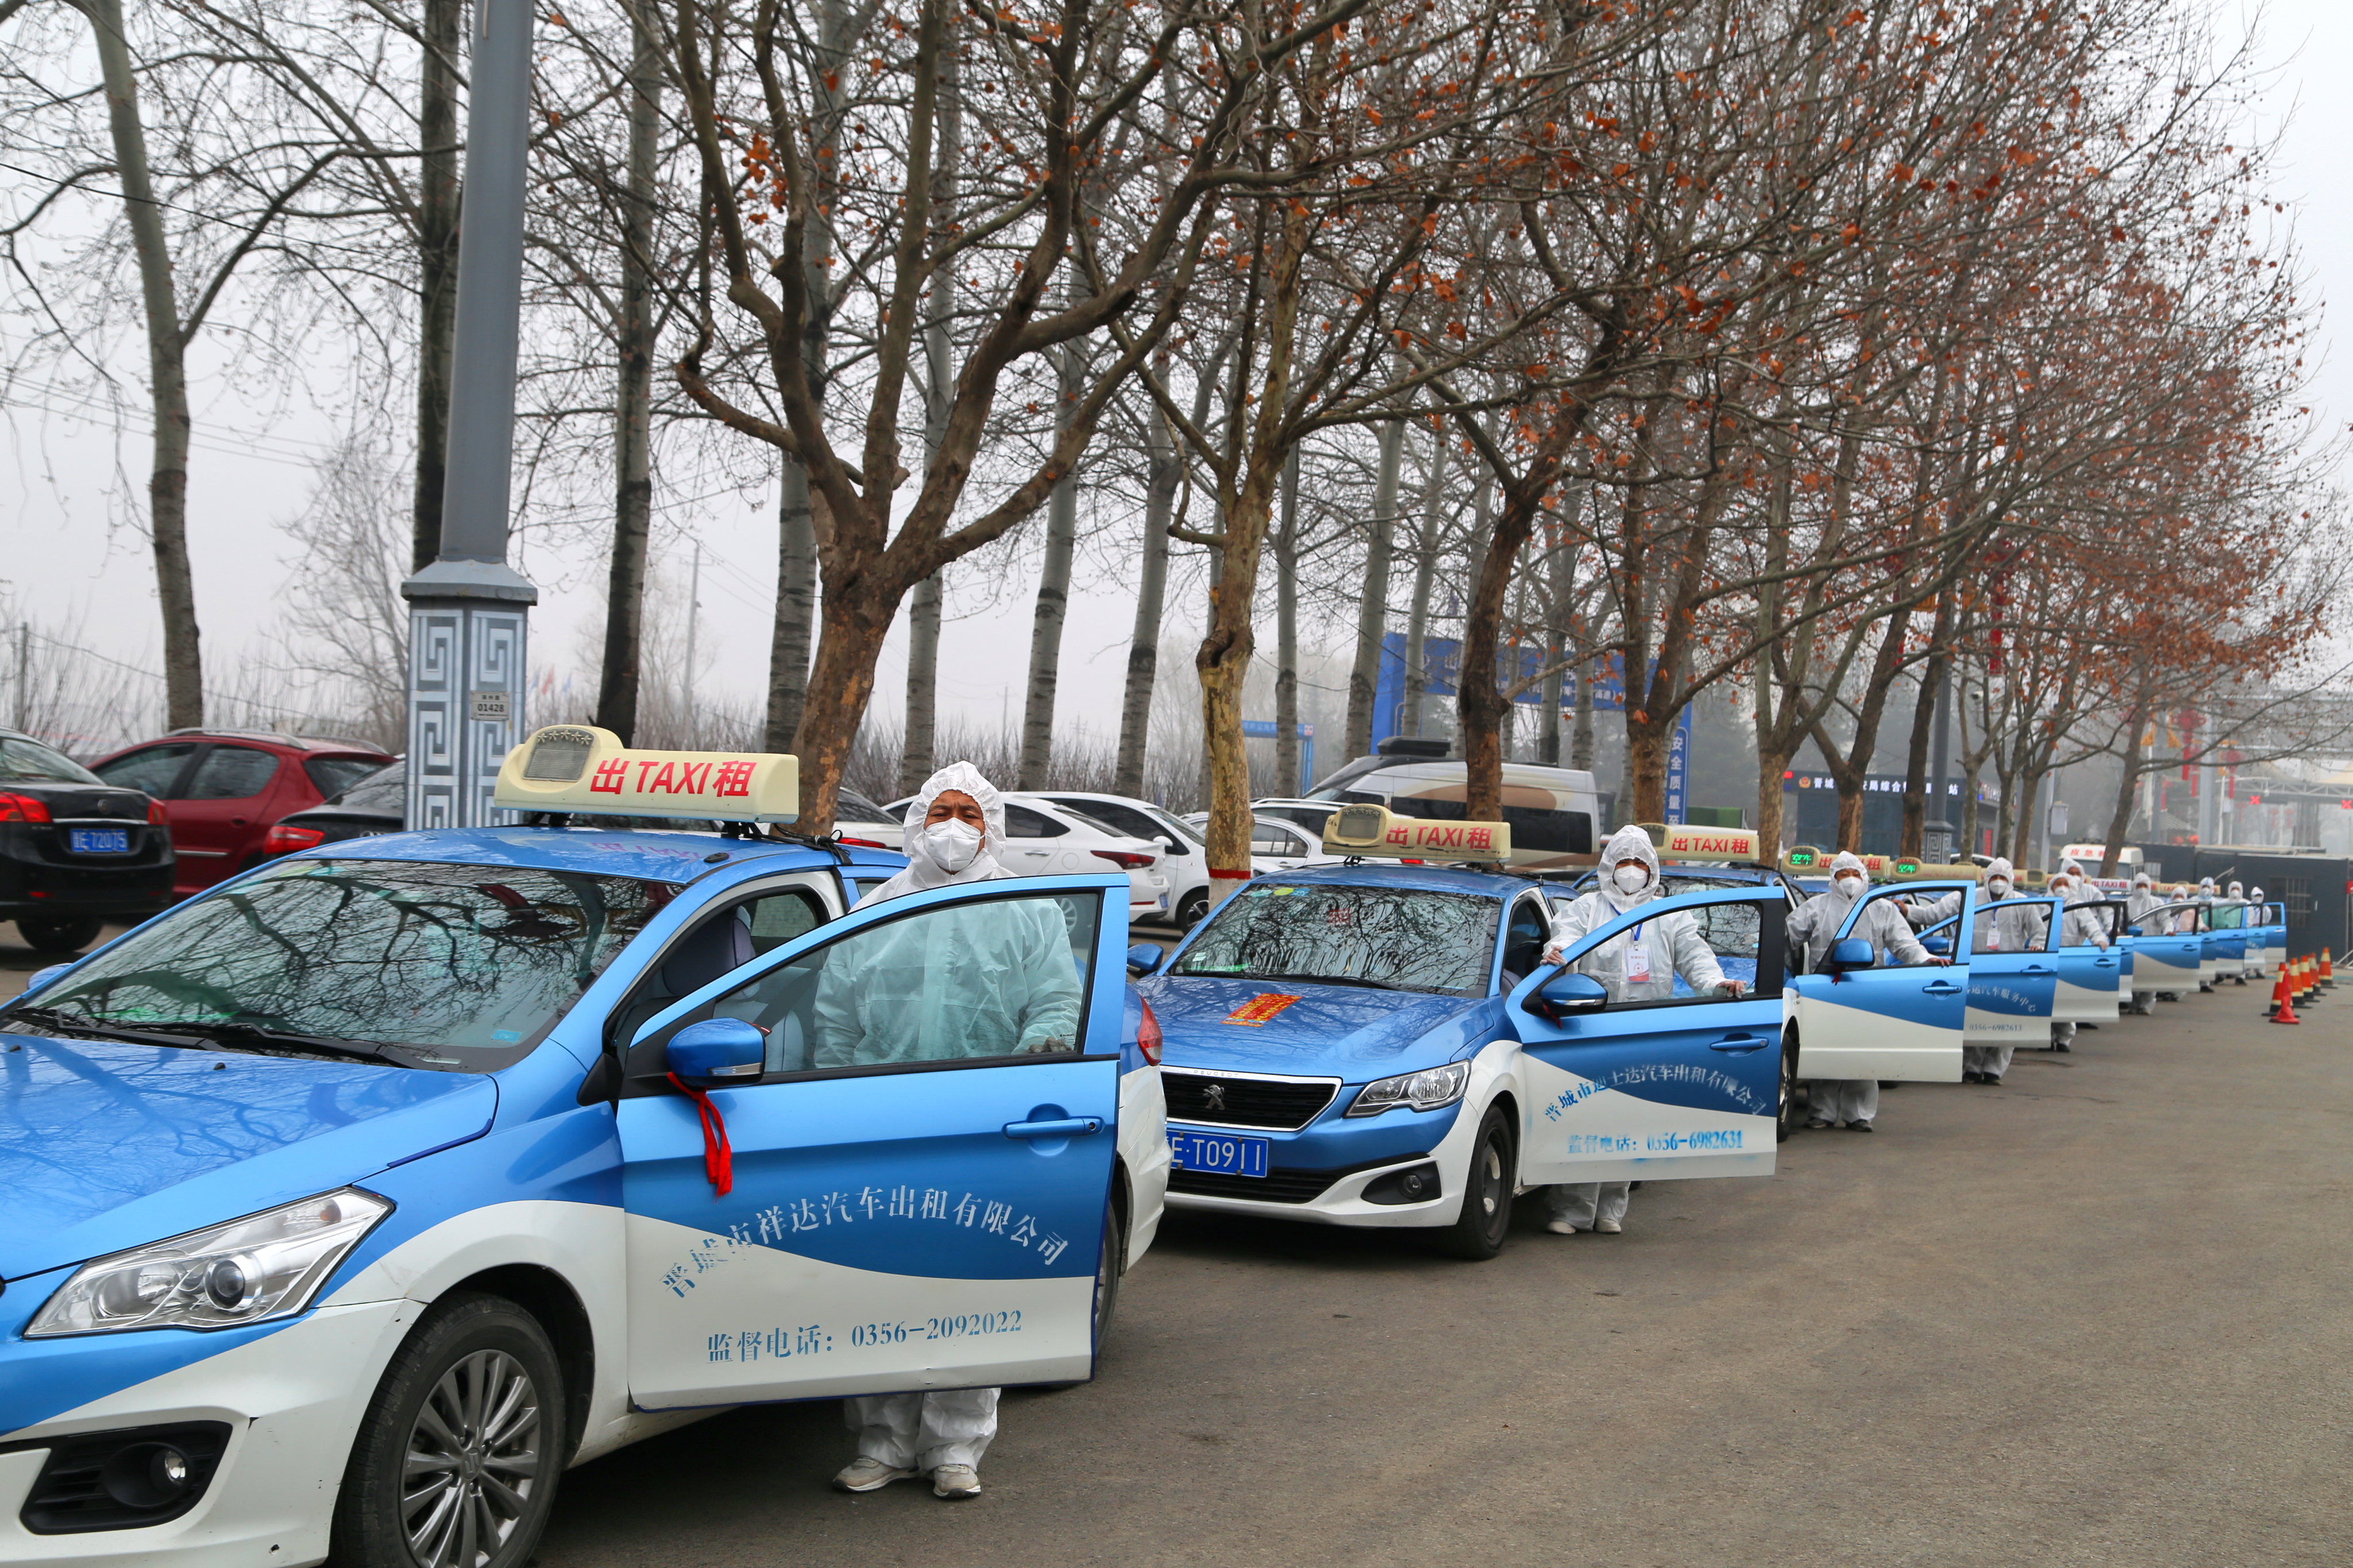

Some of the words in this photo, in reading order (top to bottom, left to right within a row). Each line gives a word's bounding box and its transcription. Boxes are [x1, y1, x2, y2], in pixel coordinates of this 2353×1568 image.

[477, 704, 504, 712] 01428
[590, 758, 630, 794] 出
[637, 761, 713, 794] TAXI
[712, 760, 757, 797] 租
[1386, 824, 1409, 845] 出
[1416, 827, 1464, 847] TAXI
[1467, 827, 1492, 849] 租
[1672, 837, 1688, 851] 出
[1693, 838, 1729, 852] TAXI
[1731, 838, 1749, 853] 租
[1194, 1069, 1239, 1077] PEUGEOT
[1544, 1064, 1766, 1122] 晋城市迪士达汽车出租有限公司
[1166, 1135, 1260, 1171] E·T0911
[659, 1185, 1068, 1298] 晋城市祥达汽车出租有限公司
[851, 1310, 1022, 1347] 0356-2092022
